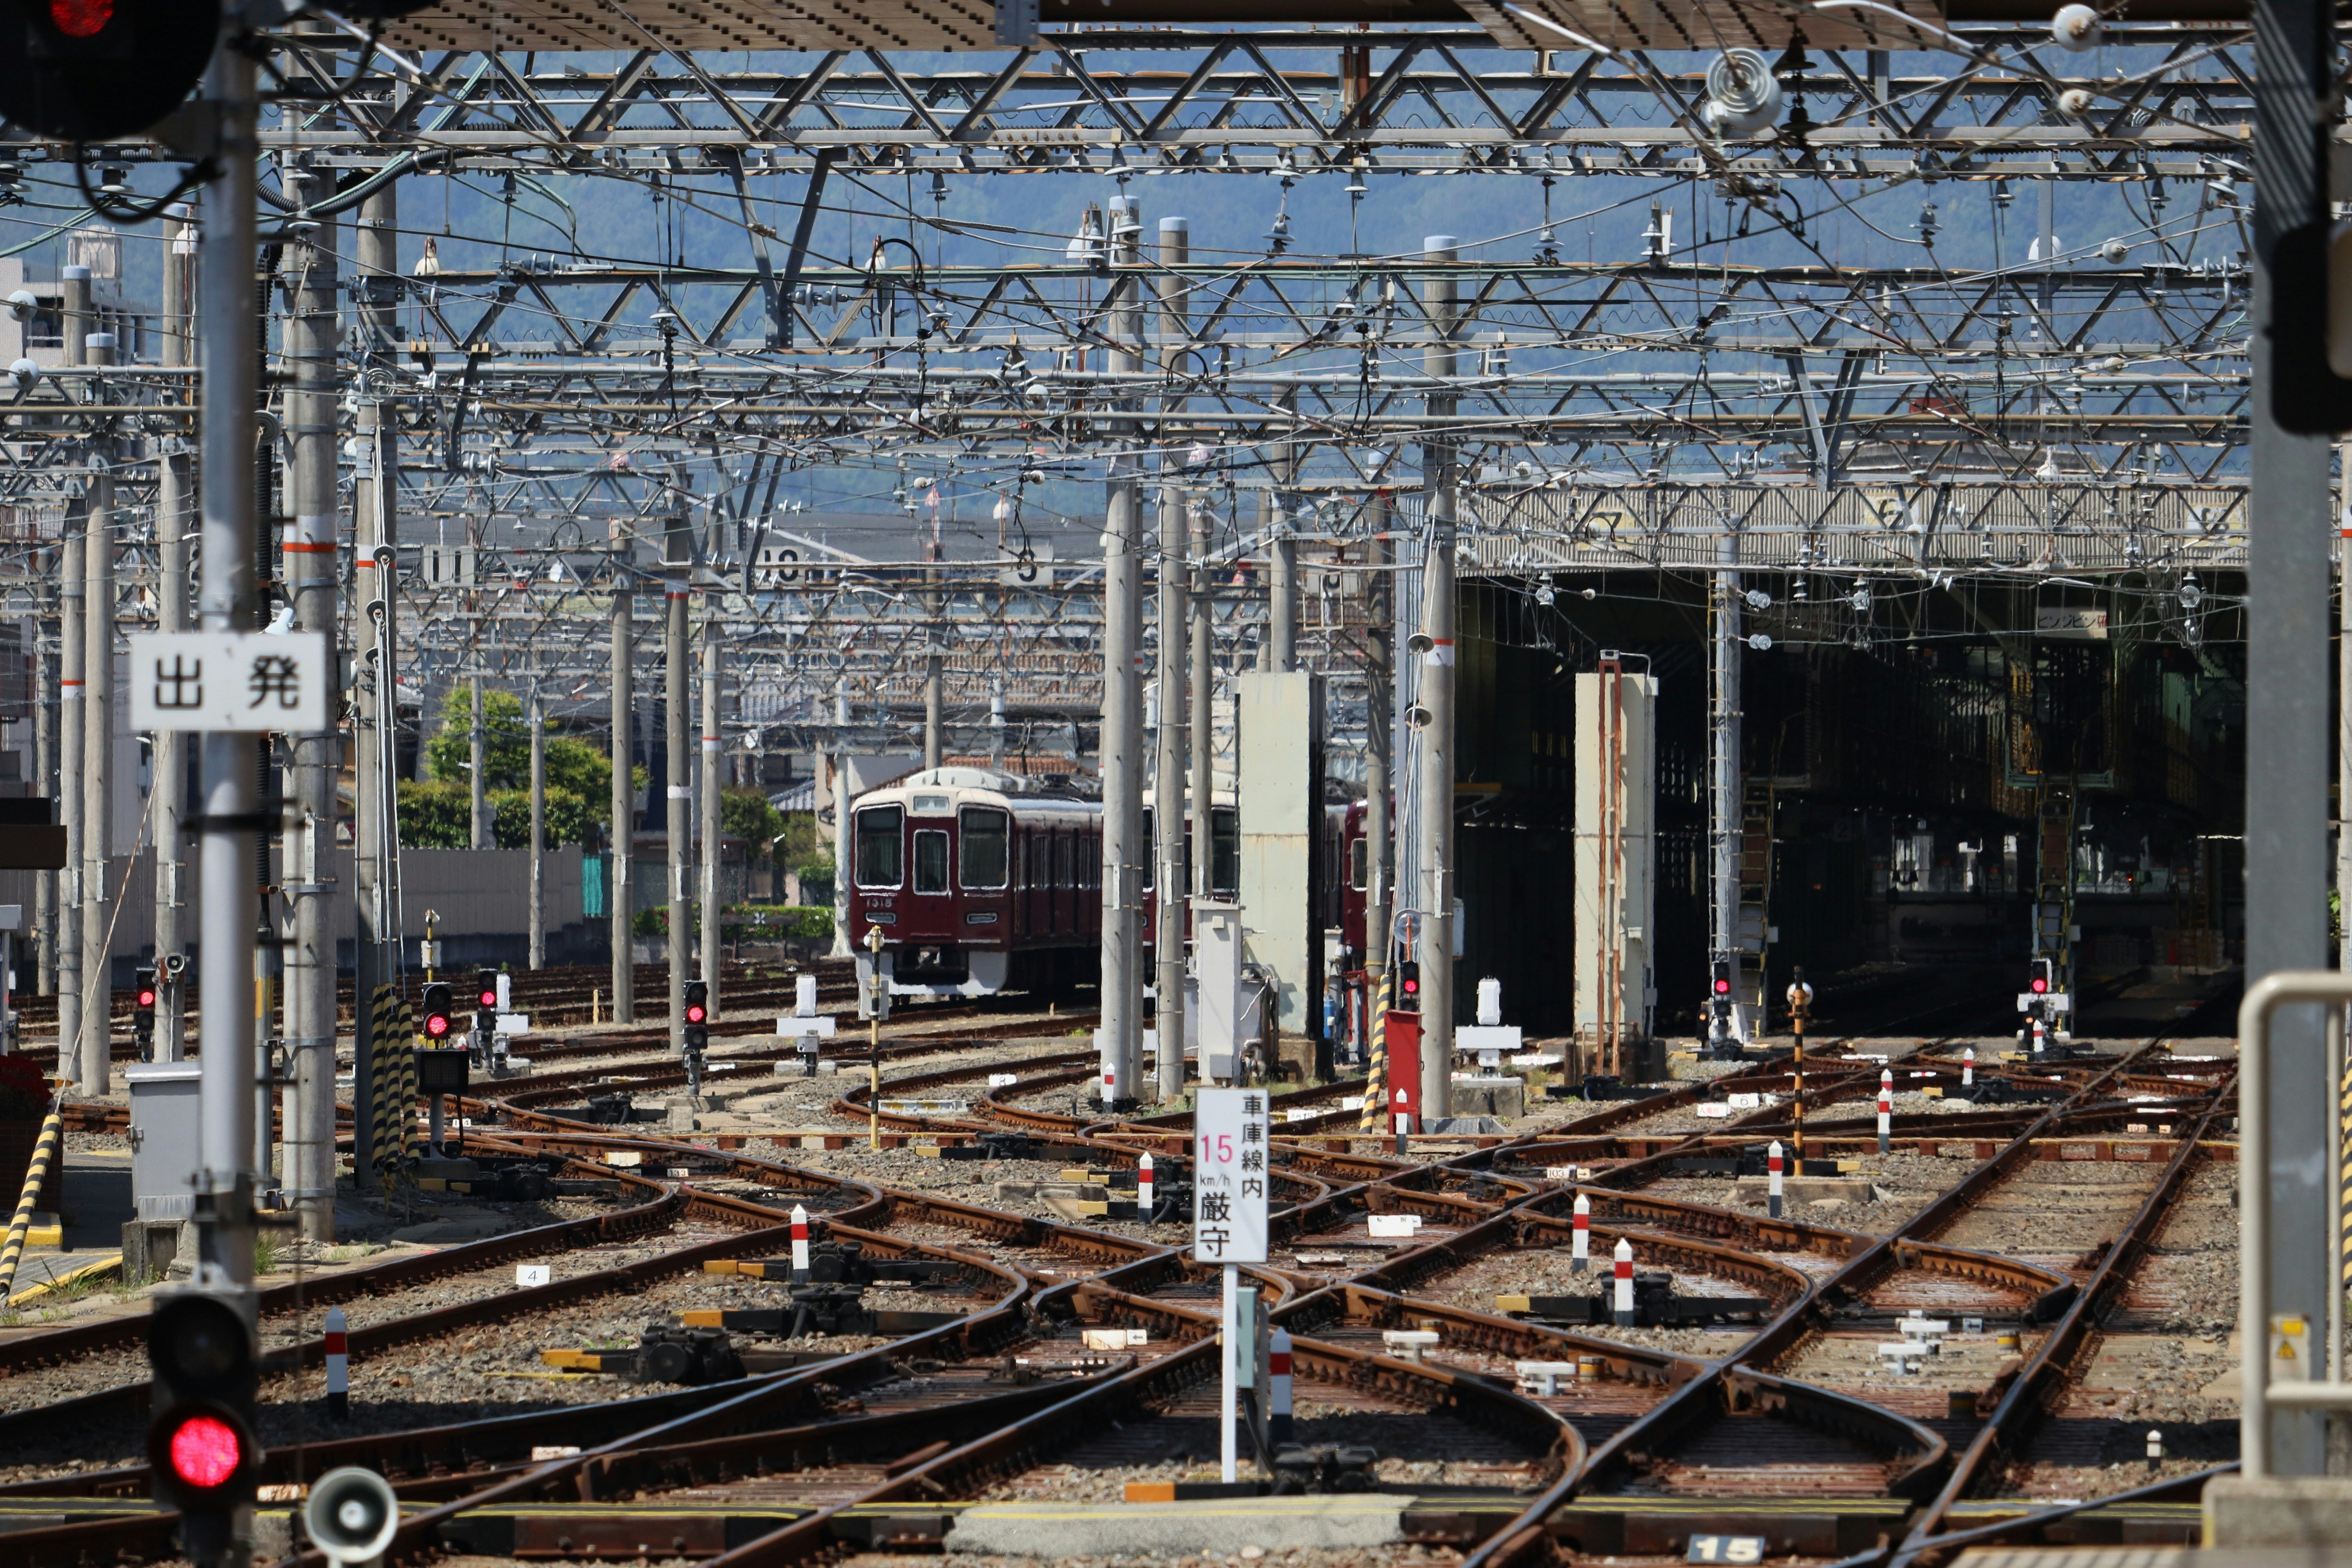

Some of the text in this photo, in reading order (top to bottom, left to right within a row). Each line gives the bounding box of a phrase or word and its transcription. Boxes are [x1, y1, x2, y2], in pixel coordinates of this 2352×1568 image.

[433, 551, 461, 583] 11
[765, 550, 798, 581] 10
[155, 654, 300, 710] 出発
[1741, 1096, 1748, 1106] 6
[1201, 1134, 1233, 1163] 15
[1241, 1095, 1264, 1199] 車庫線内
[1200, 1174, 1230, 1187] km/h
[1199, 1192, 1231, 1257] 厳守
[528, 1270, 537, 1281] 4
[1696, 1536, 1759, 1562] 15
